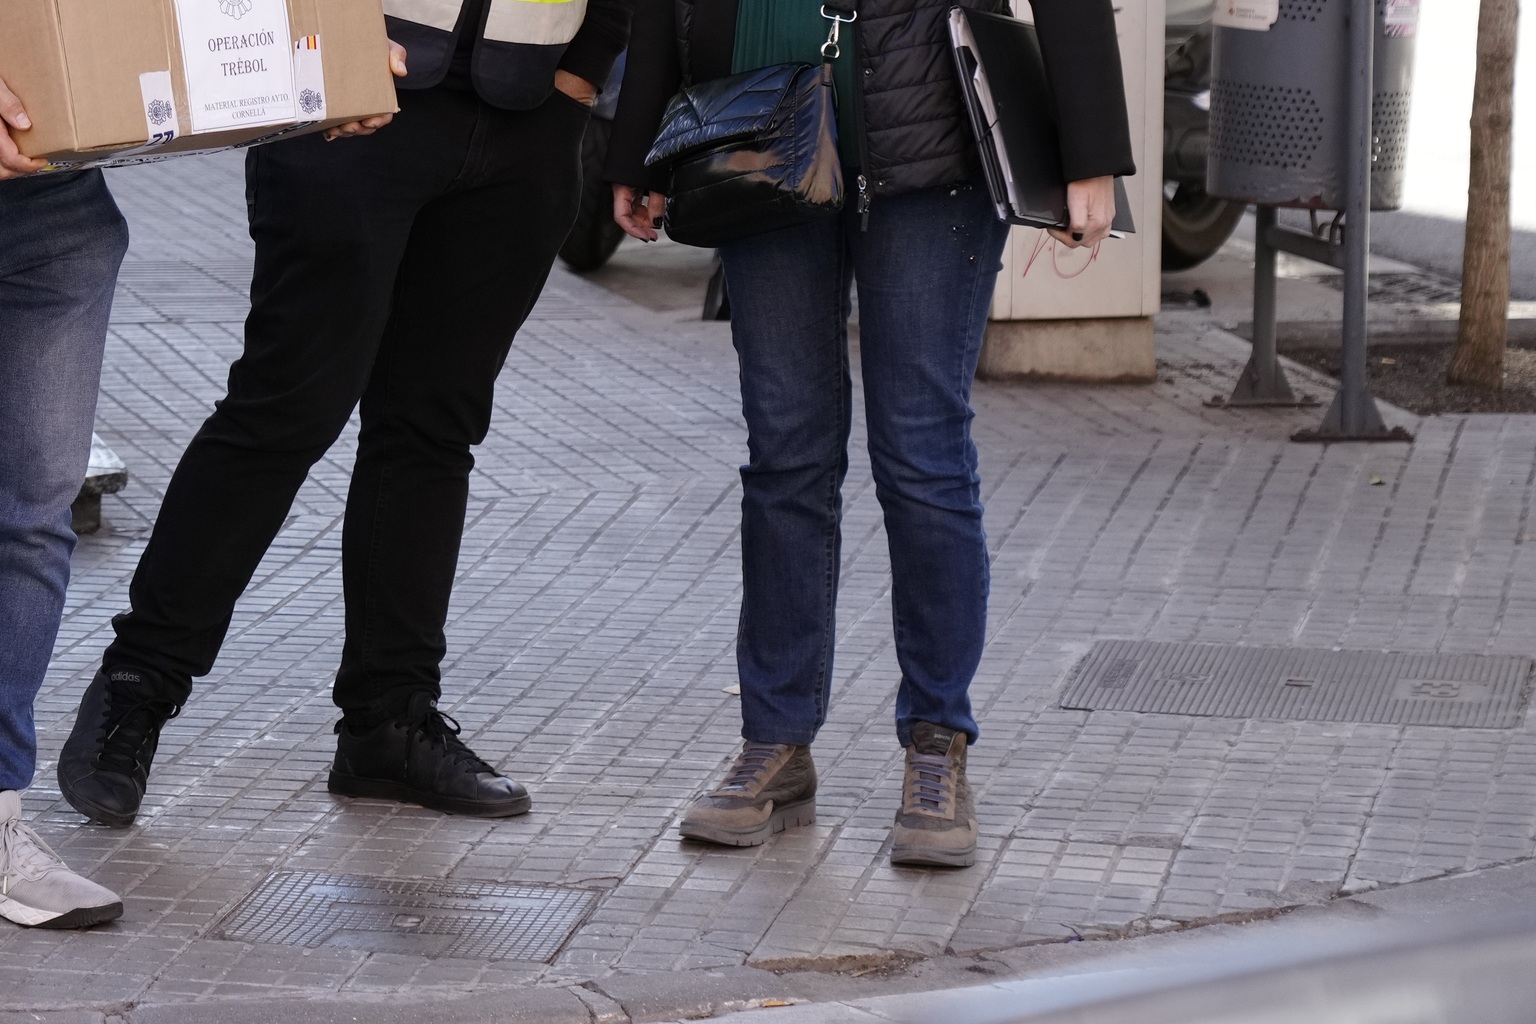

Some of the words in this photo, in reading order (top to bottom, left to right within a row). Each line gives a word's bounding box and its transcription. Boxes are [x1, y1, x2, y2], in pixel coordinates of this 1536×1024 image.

[208, 29, 274, 52] OPERACIÓN
[221, 58, 267, 77] TRÉBOL
[204, 99, 239, 112] MATERIAL
[239, 96, 270, 107] REGISTRO
[111, 671, 141, 683] adidas
